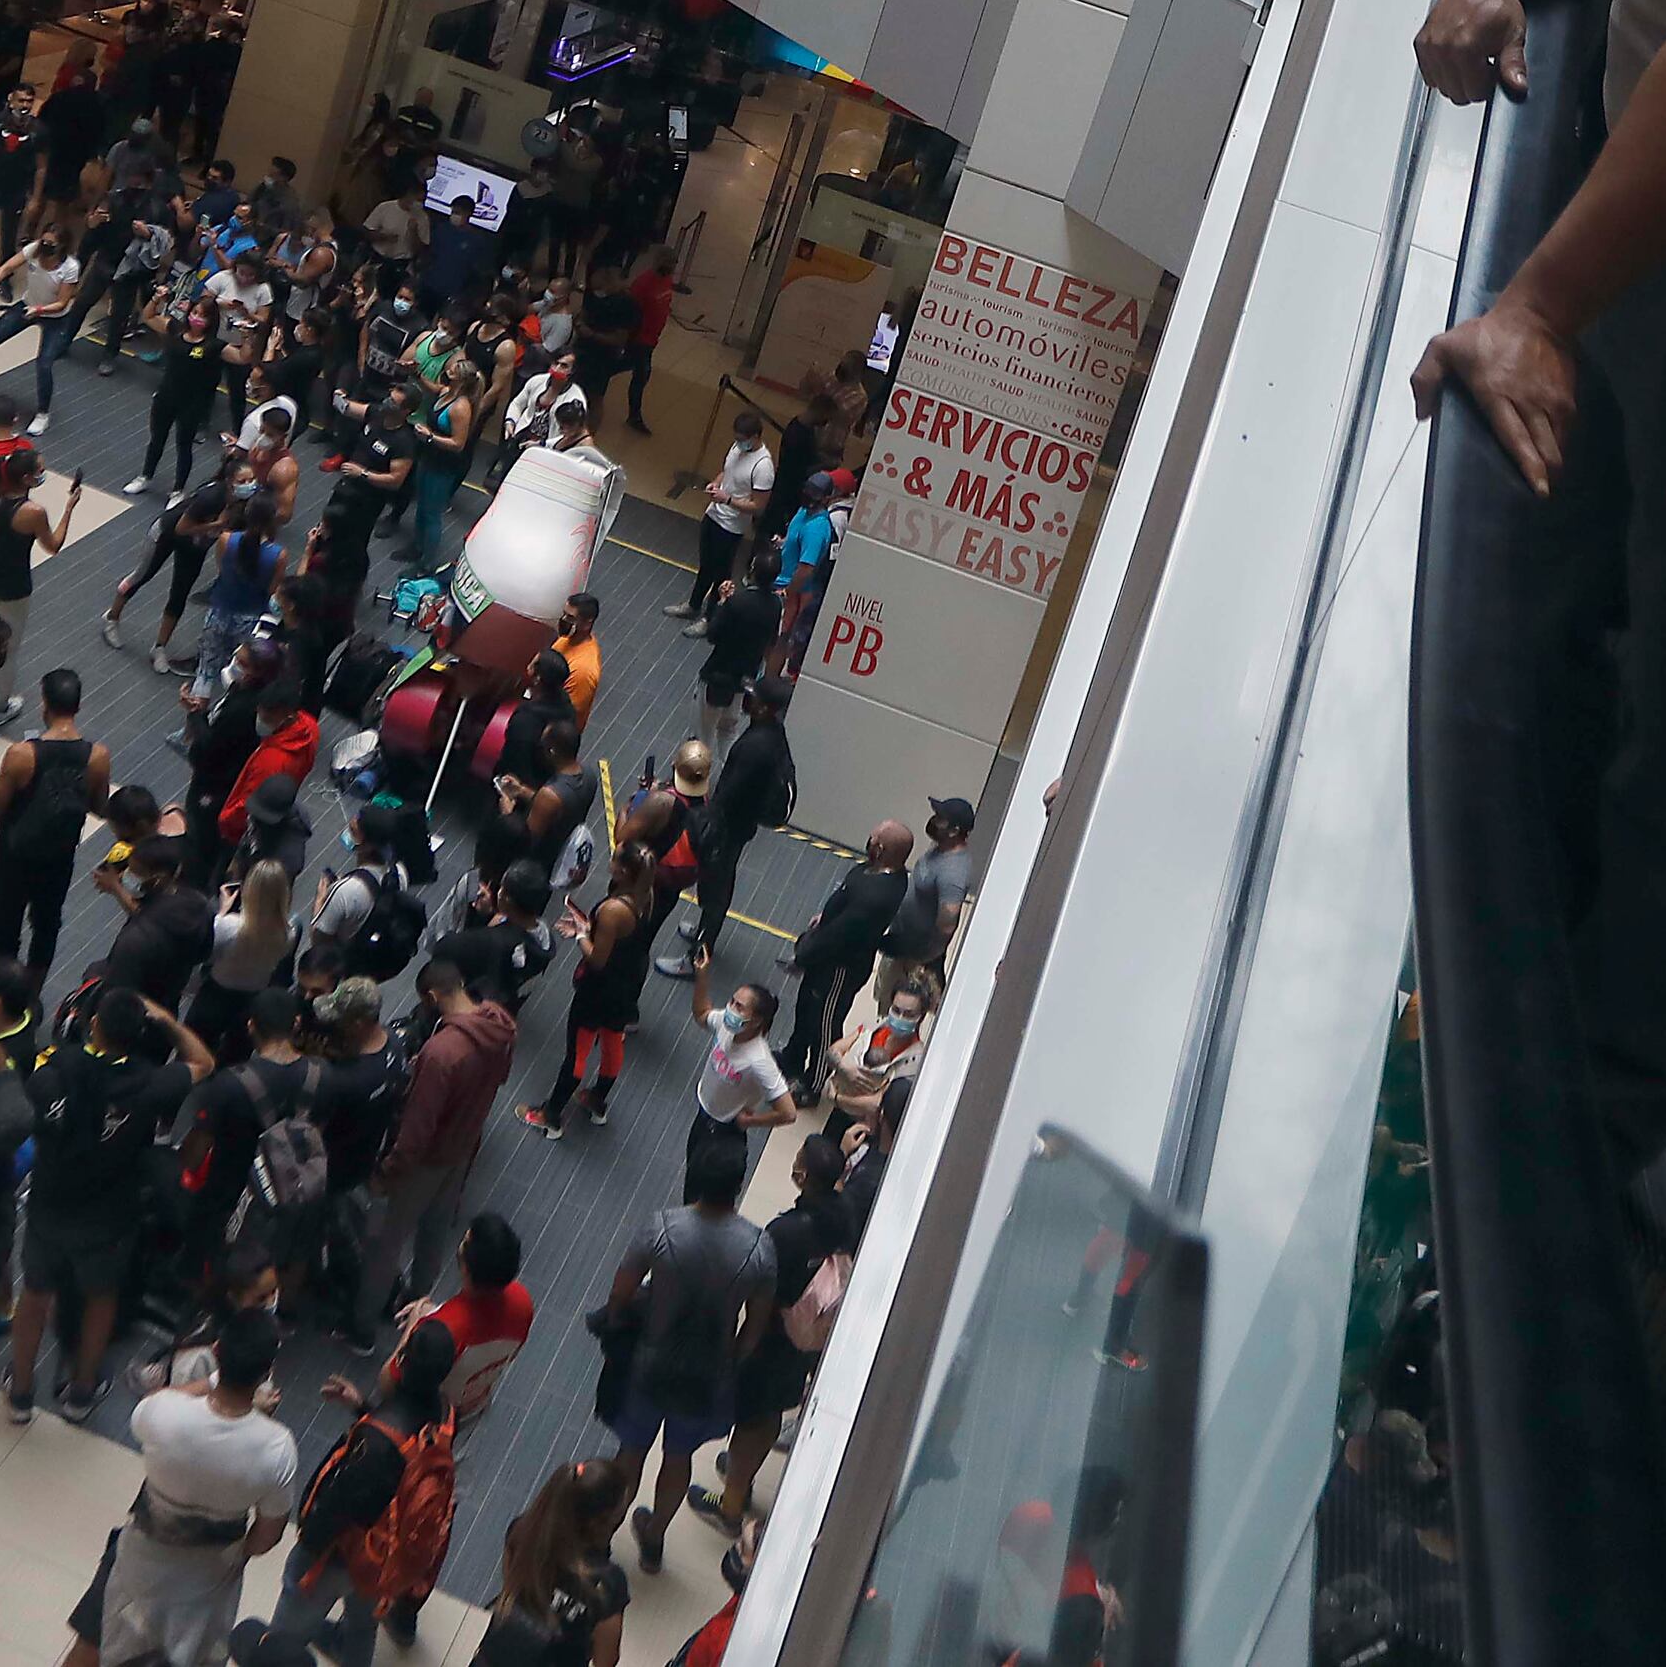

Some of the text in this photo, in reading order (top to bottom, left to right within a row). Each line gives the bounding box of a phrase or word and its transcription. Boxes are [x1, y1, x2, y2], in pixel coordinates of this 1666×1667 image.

[928, 280, 1134, 357] turismo tourism turismo tourism
[933, 235, 1141, 341] BELLEZA
[911, 328, 1117, 410] servicios financieros
[920, 298, 1128, 386] automóviles
[900, 366, 1103, 447] COMUNICACIONES CARS
[905, 349, 940, 368] SALUD
[942, 359, 986, 383] HEALTH
[989, 377, 1024, 398] SALUD
[1074, 407, 1110, 427] SALUD
[884, 388, 1096, 494] SERVICIOS
[903, 455, 1040, 535] & MÁS
[849, 489, 1062, 595] EASY EASY
[822, 614, 884, 677] PB
[843, 591, 884, 625] NIVEL
